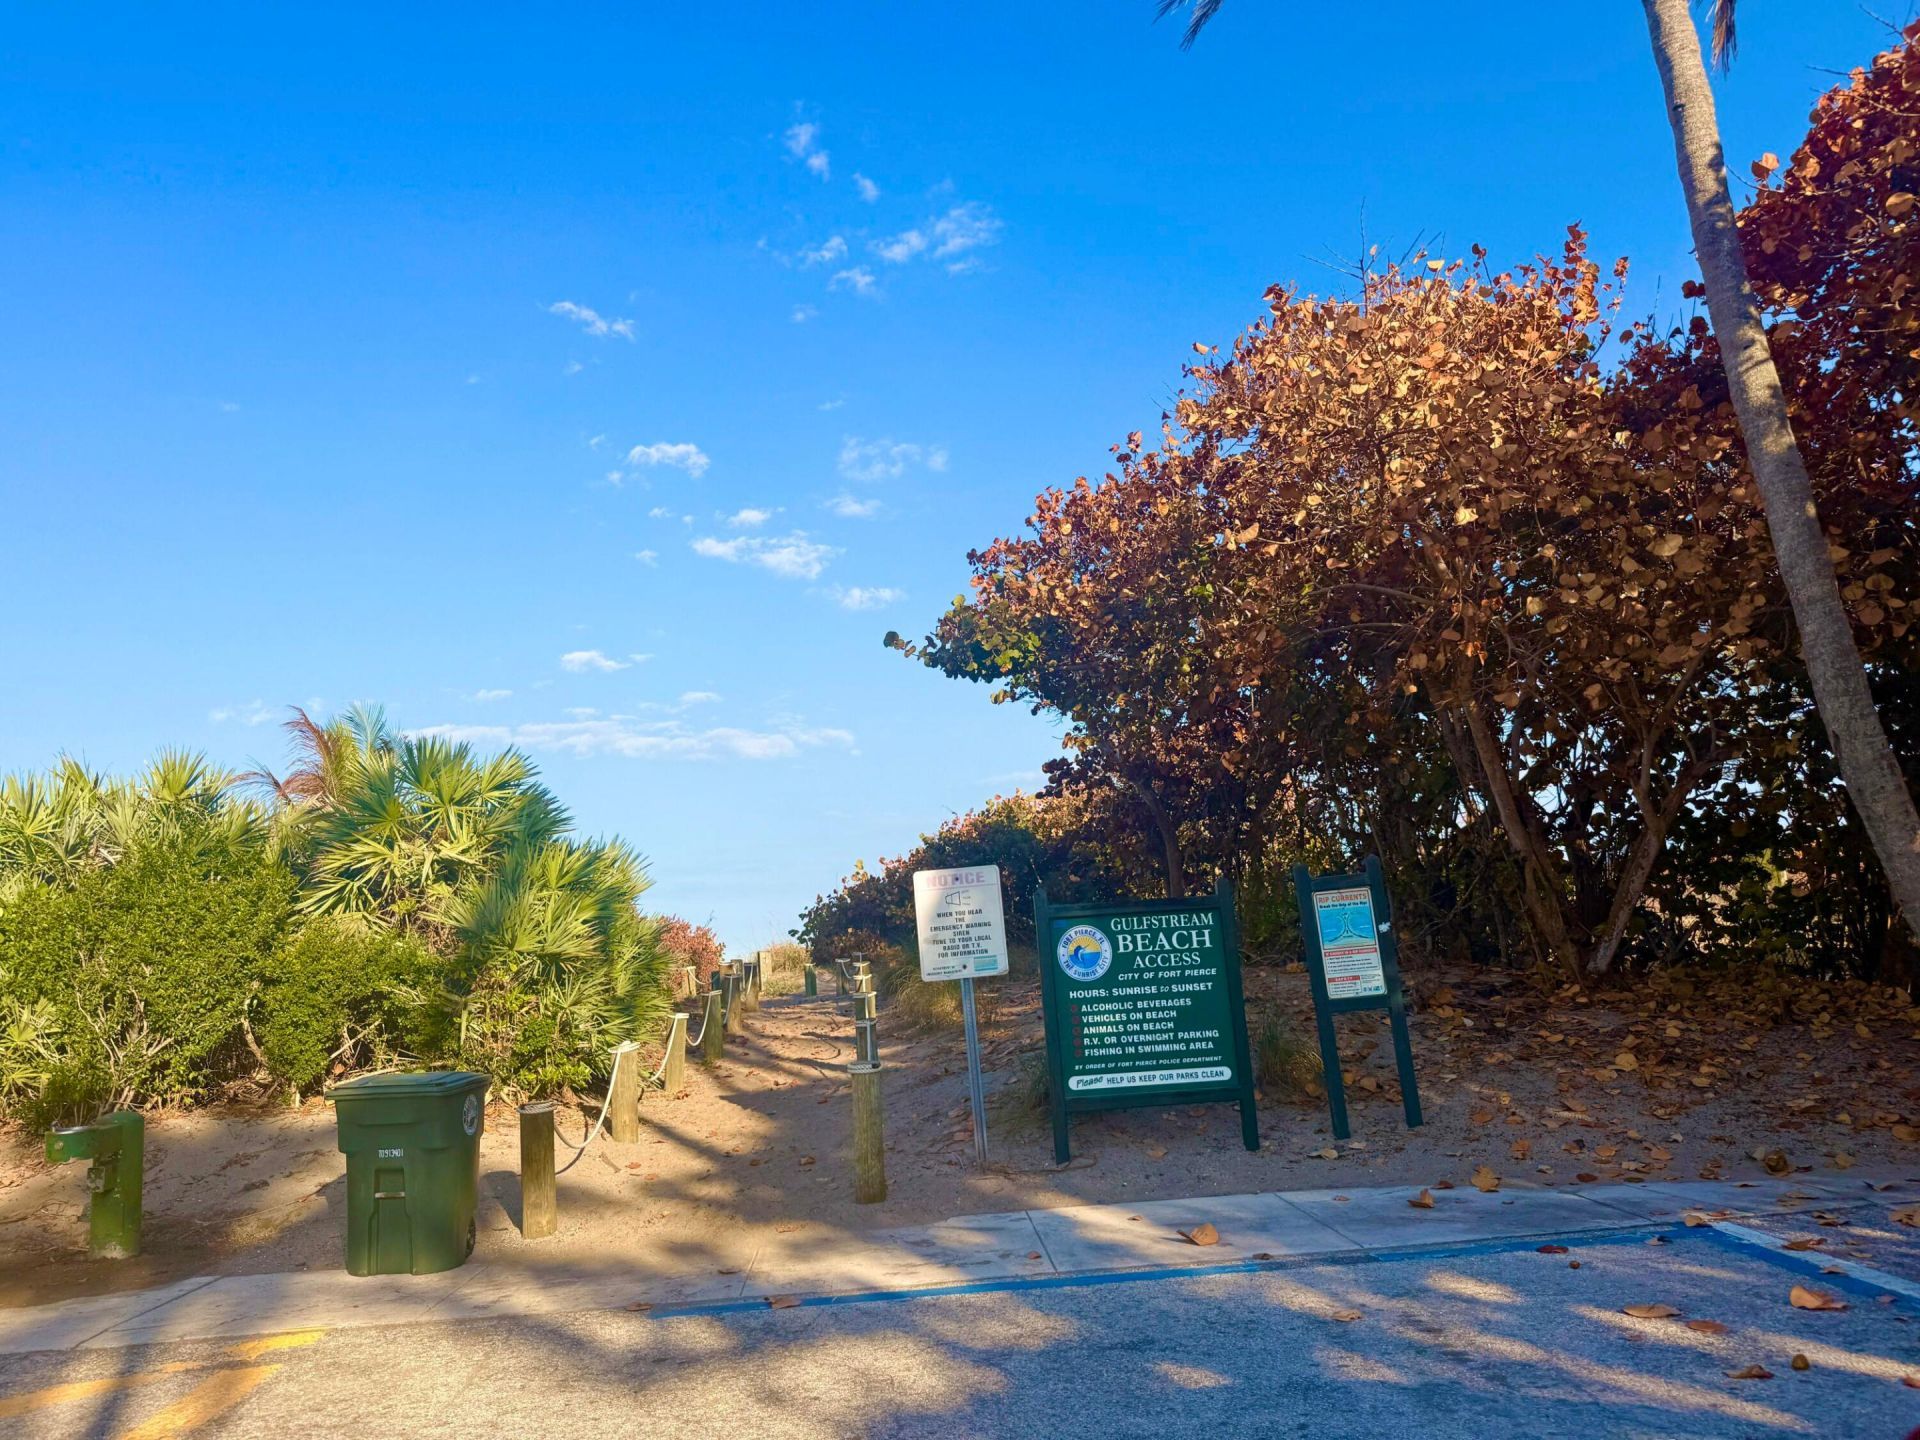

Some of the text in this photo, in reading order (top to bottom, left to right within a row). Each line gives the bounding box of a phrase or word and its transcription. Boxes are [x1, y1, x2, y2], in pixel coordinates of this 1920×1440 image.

[927, 872, 984, 888] NOTICE
[1331, 892, 1367, 902] CURRENTS
[1110, 912, 1214, 931] GULFSTREAM
[1062, 934, 1073, 948] FORT
[1116, 929, 1213, 953] BEACH
[951, 949, 988, 957] INFORMATION
[1133, 952, 1201, 968] ACCESS
[1063, 956, 1109, 978] THE SUNRISE CITY
[1118, 972, 1140, 981] CITY
[1185, 968, 1217, 976] PIERCE
[1069, 990, 1109, 999] HOURS:
[1112, 986, 1158, 996] SUNRISE
[1171, 982, 1213, 992] SUNSET
[1081, 998, 1192, 1012] ALCOHOLIC BEVERAGES
[1082, 1014, 1127, 1023] VEHICLES
[1146, 1010, 1177, 1019] BEACH
[1083, 1024, 1124, 1034] ANIMALS
[1143, 1022, 1174, 1031] BEACH
[1084, 1038, 1101, 1046] R.V.
[1121, 1032, 1174, 1043] OVERNIGHT
[1178, 1030, 1219, 1039] PARKING
[1085, 1041, 1214, 1057] FISHING IN SWIMMING AREA
[1076, 1076, 1103, 1088] Please
[1106, 1075, 1125, 1084] HELP
[1139, 1074, 1157, 1082] KEEP
[1176, 1072, 1199, 1080] PARKS
[1201, 1070, 1224, 1078] CLEAN
